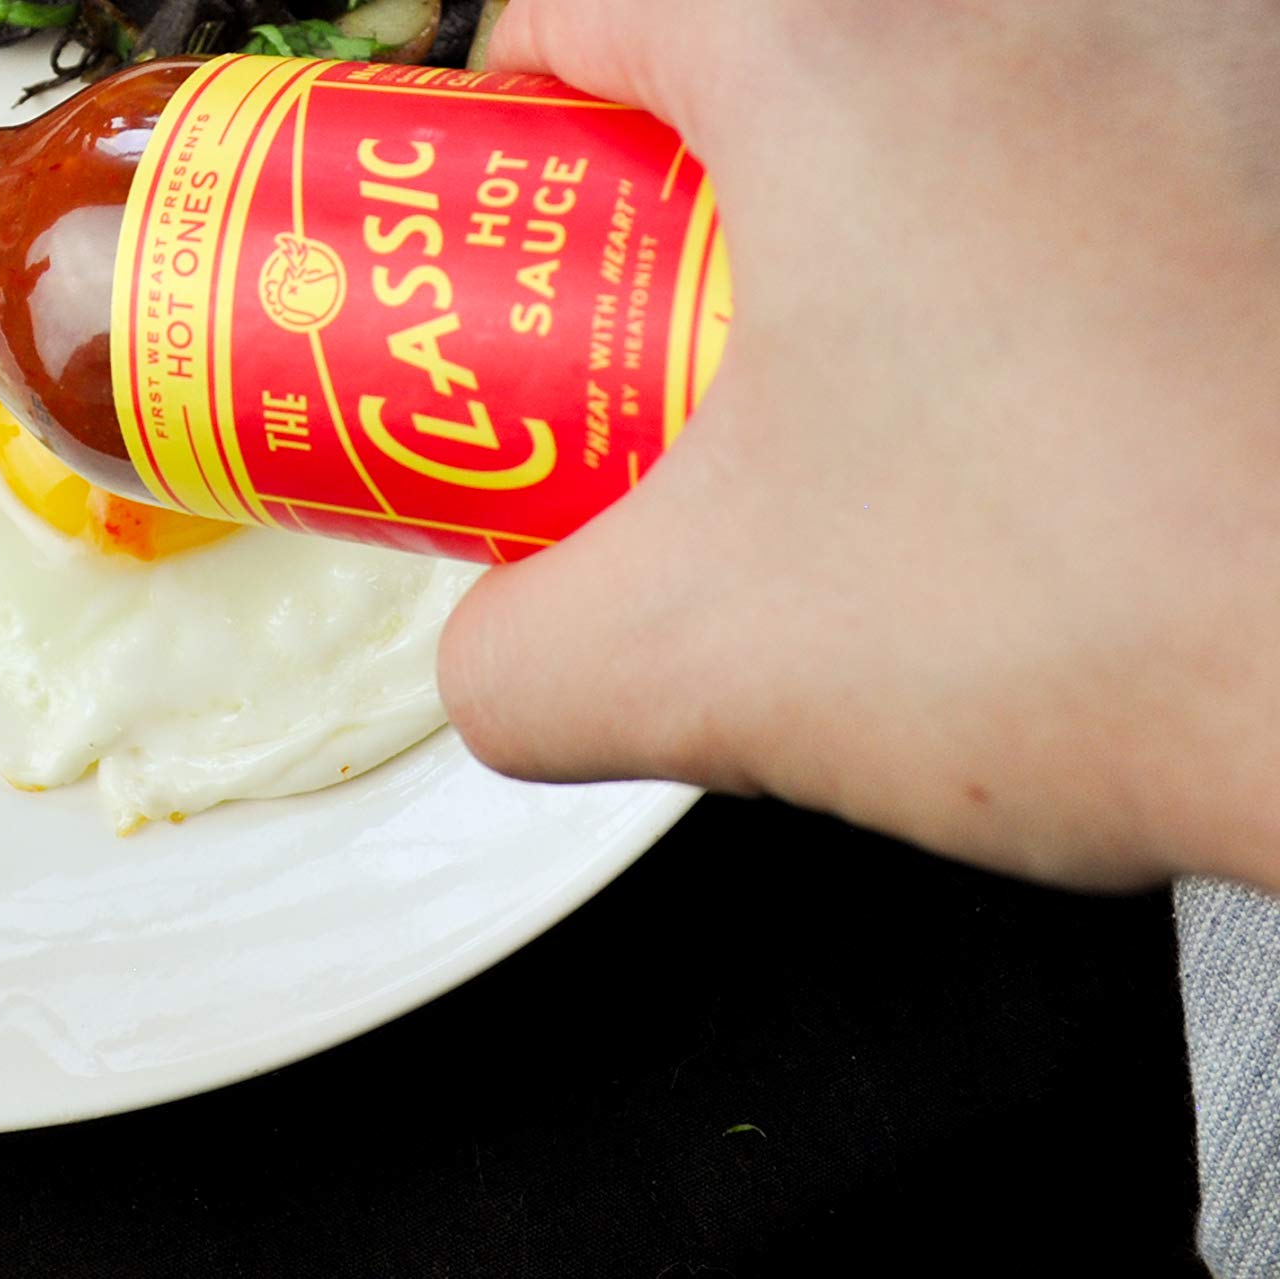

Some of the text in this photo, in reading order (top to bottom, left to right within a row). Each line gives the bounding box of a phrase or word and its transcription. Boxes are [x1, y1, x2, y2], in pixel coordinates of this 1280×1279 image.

[146, 114, 211, 440] FIRST WE FEAST PRESENTS
[168, 170, 218, 380] HOT ONES
[465, 150, 528, 248] HOT
[510, 156, 589, 336] SAUCE
[357, 138, 557, 490] CLASSIC
[583, 179, 635, 469] "HEAT WITH HEART"
[622, 234, 659, 416] BY HEATONIST
[262, 390, 312, 453] THE
